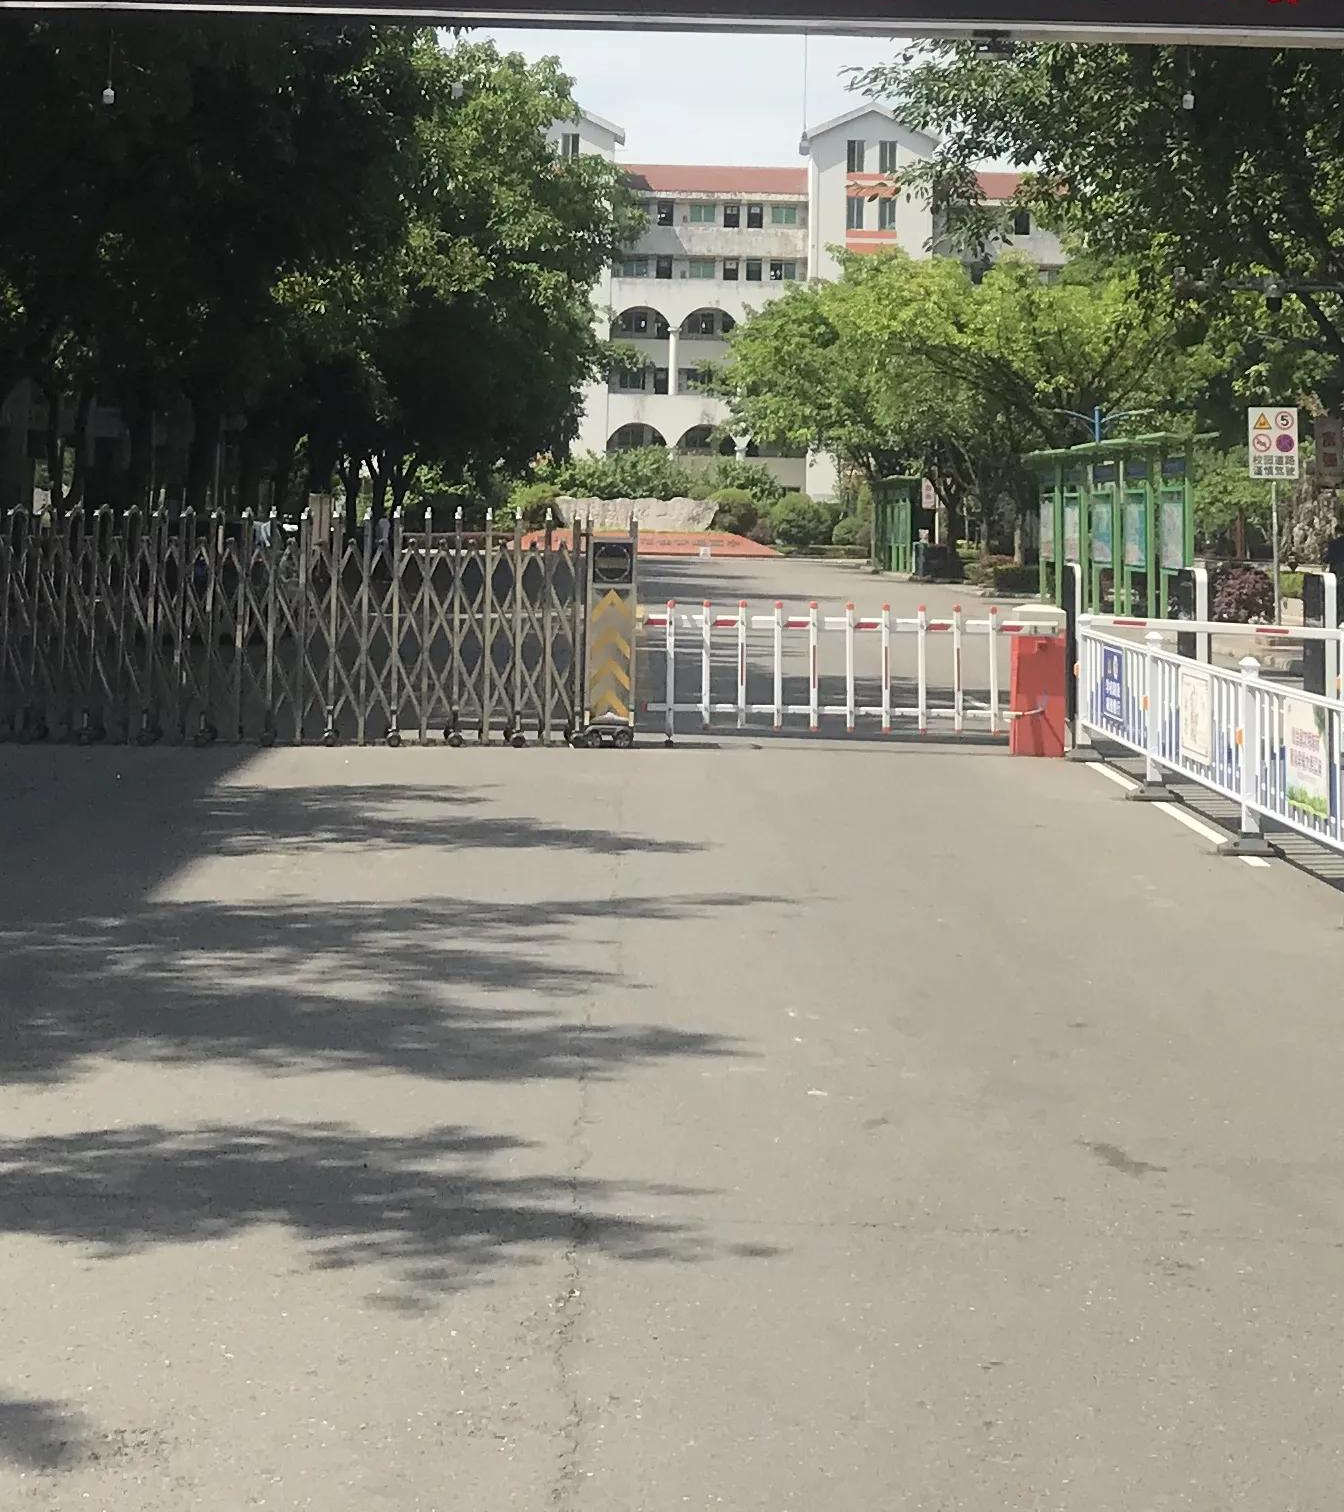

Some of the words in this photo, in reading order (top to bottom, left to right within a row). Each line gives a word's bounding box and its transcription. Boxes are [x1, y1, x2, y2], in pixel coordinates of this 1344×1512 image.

[1279, 414, 1290, 427] 5
[1252, 455, 1296, 466] 校园道路
[1252, 465, 1296, 477] 谨慎驾驶
